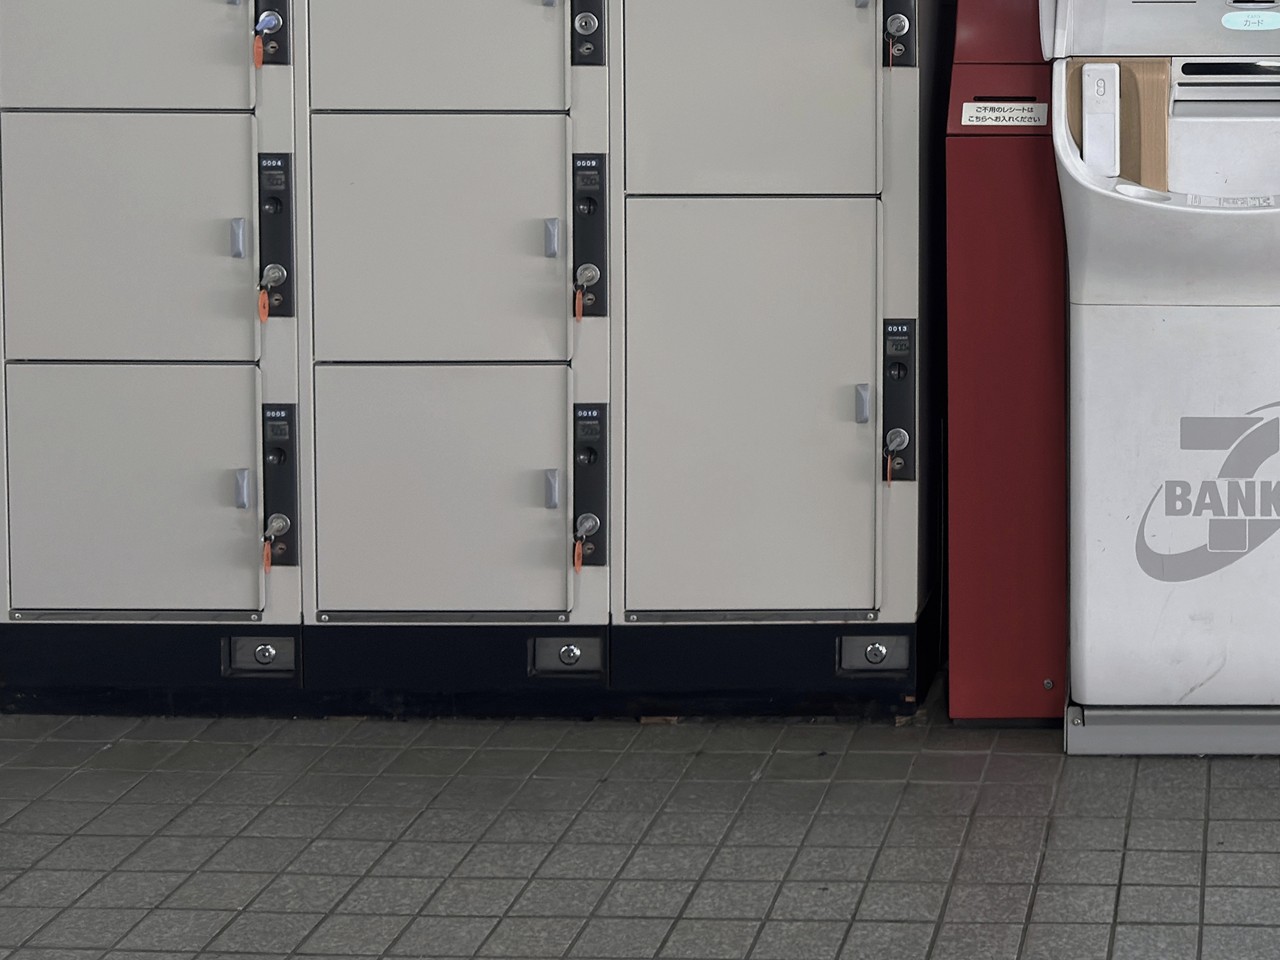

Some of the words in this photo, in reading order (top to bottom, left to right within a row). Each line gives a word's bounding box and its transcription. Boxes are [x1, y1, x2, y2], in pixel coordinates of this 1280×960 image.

[1243, 19, 1264, 27] カード
[976, 106, 1034, 114] ご不用のレシートは
[967, 115, 1041, 123] こちらへお入れください
